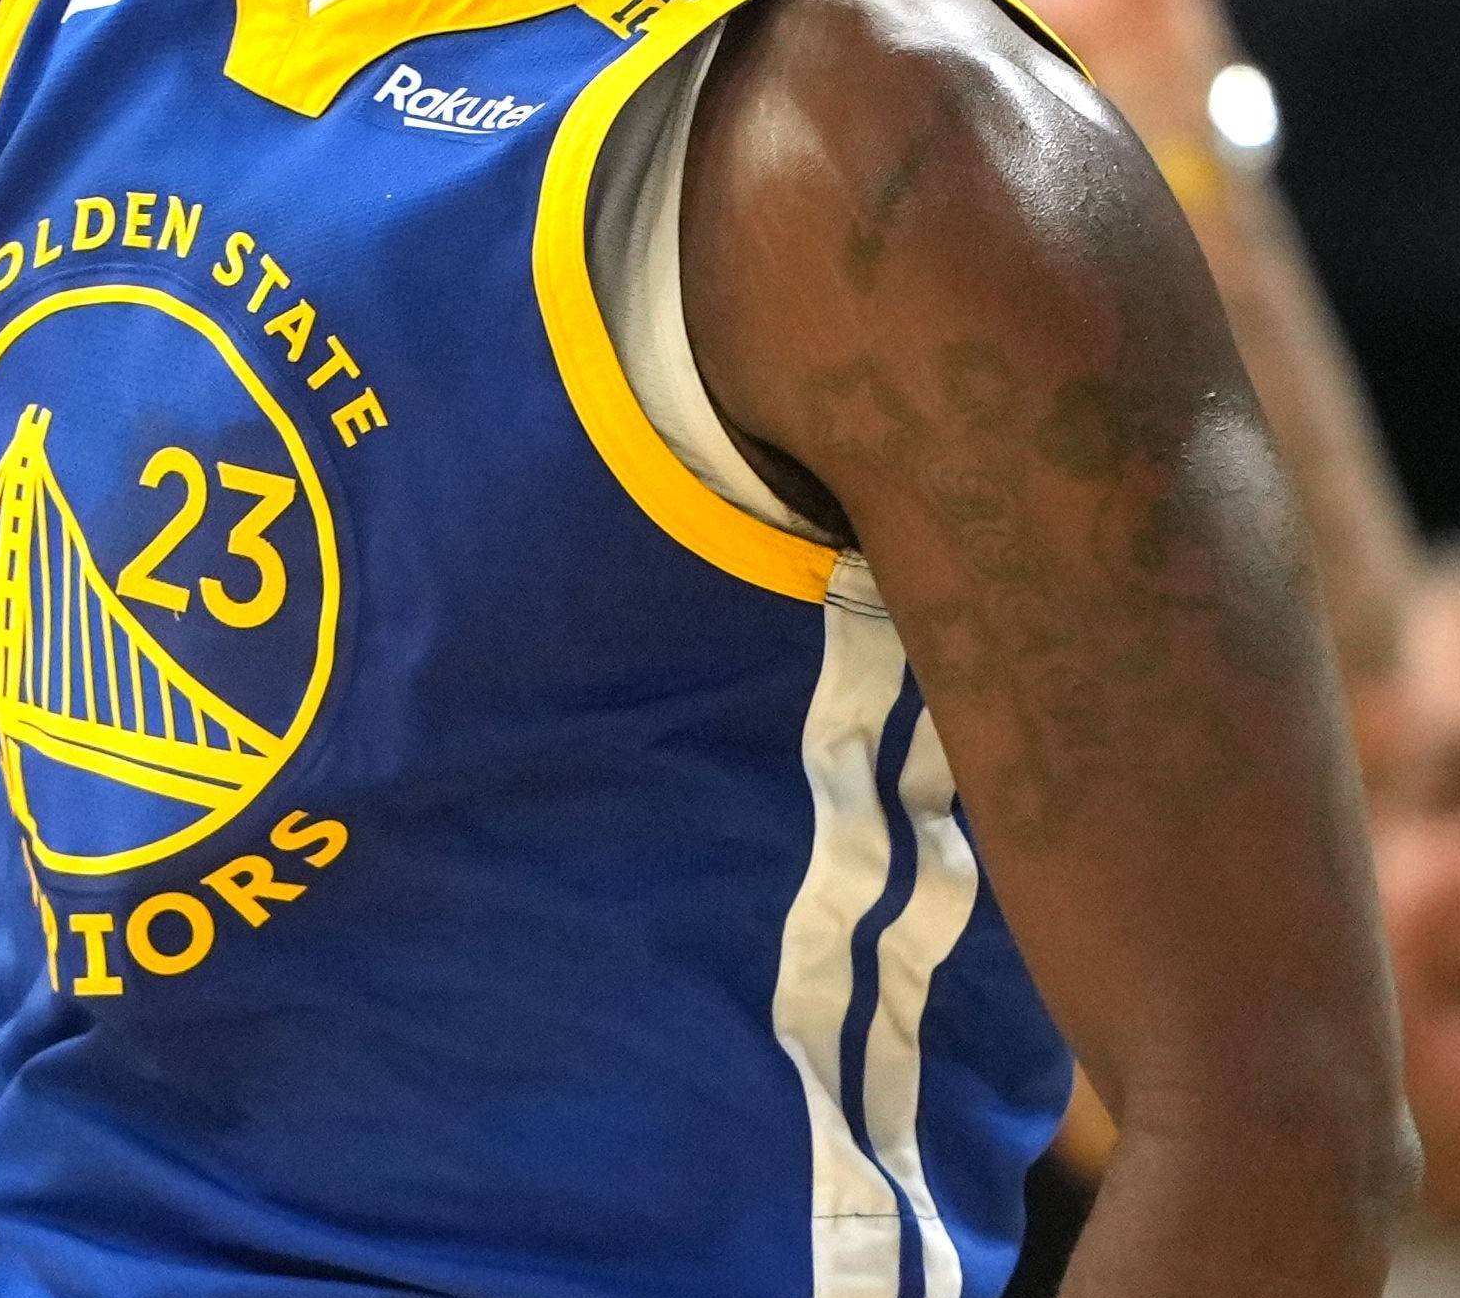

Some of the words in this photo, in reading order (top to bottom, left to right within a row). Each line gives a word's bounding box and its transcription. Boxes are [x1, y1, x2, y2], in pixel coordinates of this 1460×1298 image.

[374, 64, 545, 130] Rakute
[211, 231, 389, 448] STATE
[116, 446, 296, 629] 23
